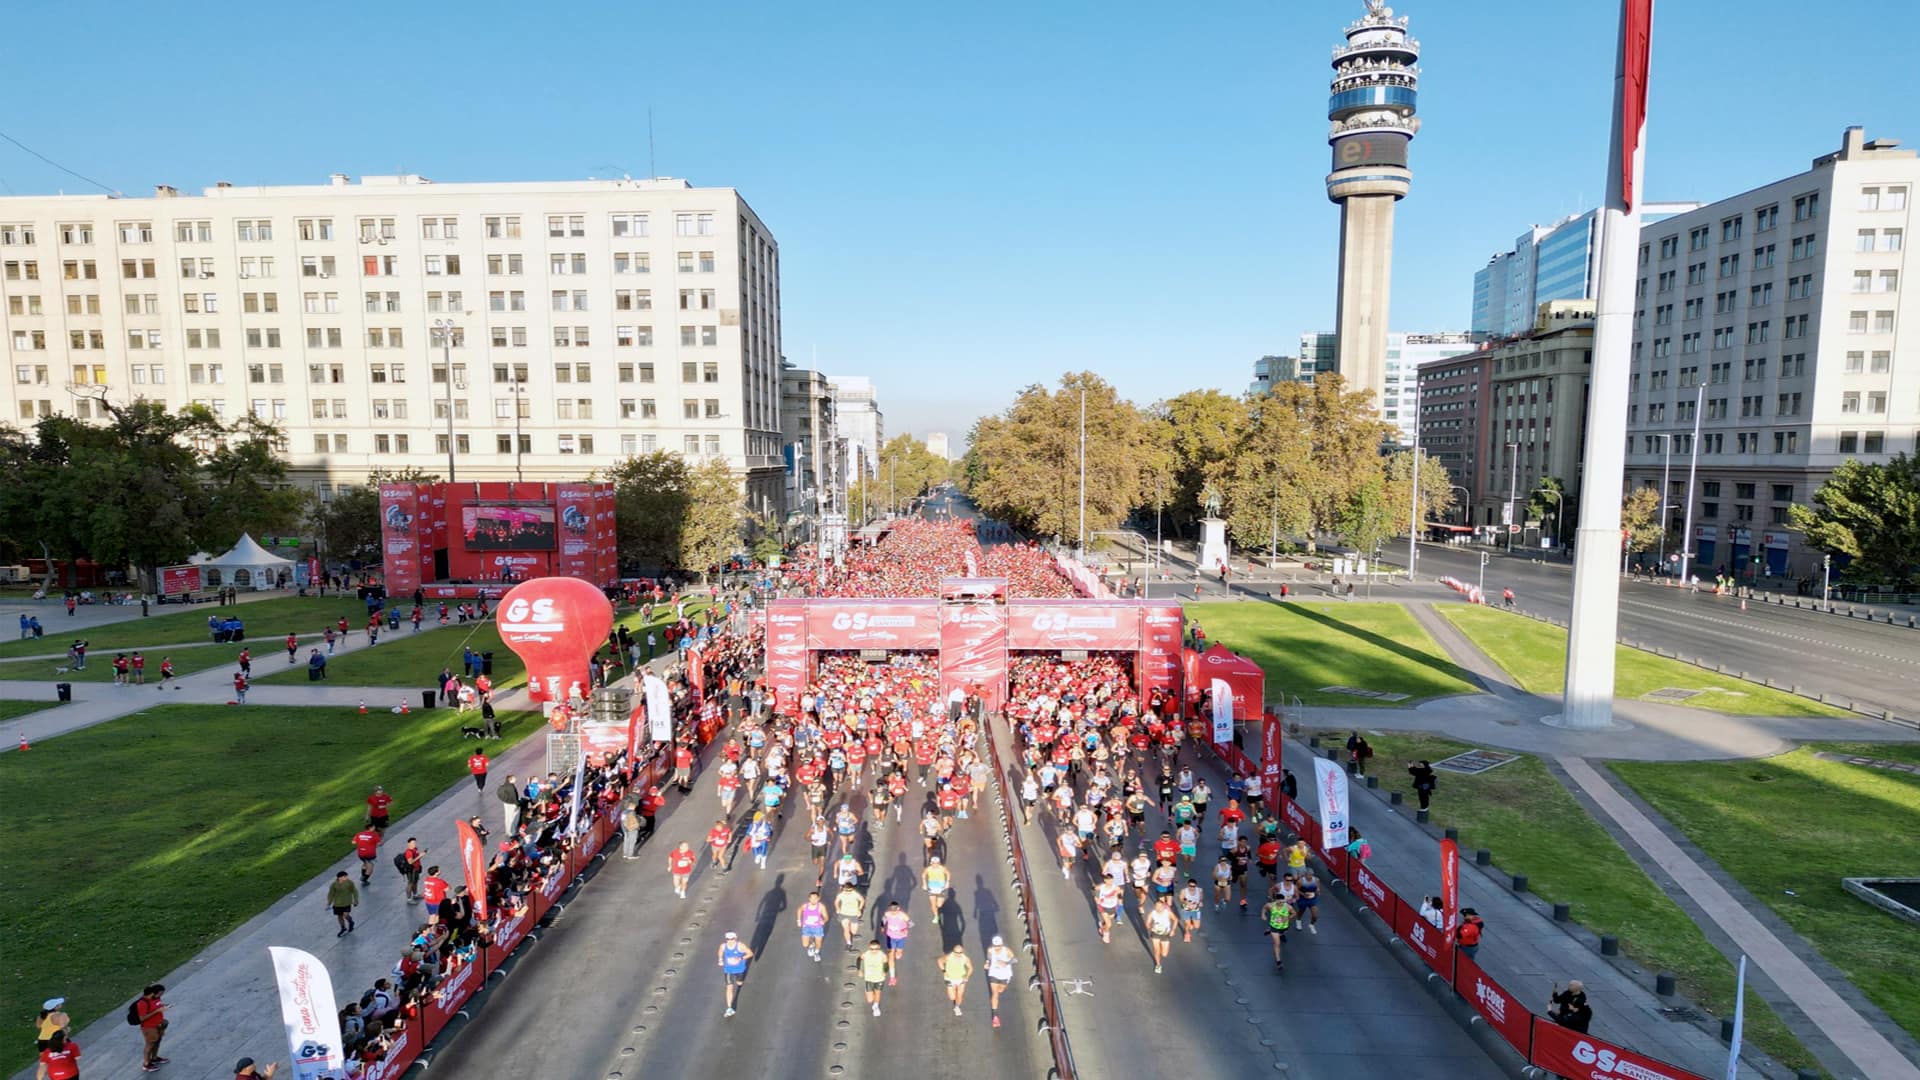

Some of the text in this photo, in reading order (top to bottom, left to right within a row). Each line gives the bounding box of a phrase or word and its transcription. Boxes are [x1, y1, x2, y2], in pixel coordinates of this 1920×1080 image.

[505, 598, 555, 623] GS
[831, 612, 867, 631] GS
[1031, 612, 1069, 632] GS
[1329, 821, 1344, 830] GS
[291, 962, 317, 1035] Gana Santiago
[300, 1044, 330, 1059] GS
[1571, 1040, 1617, 1073] GS
